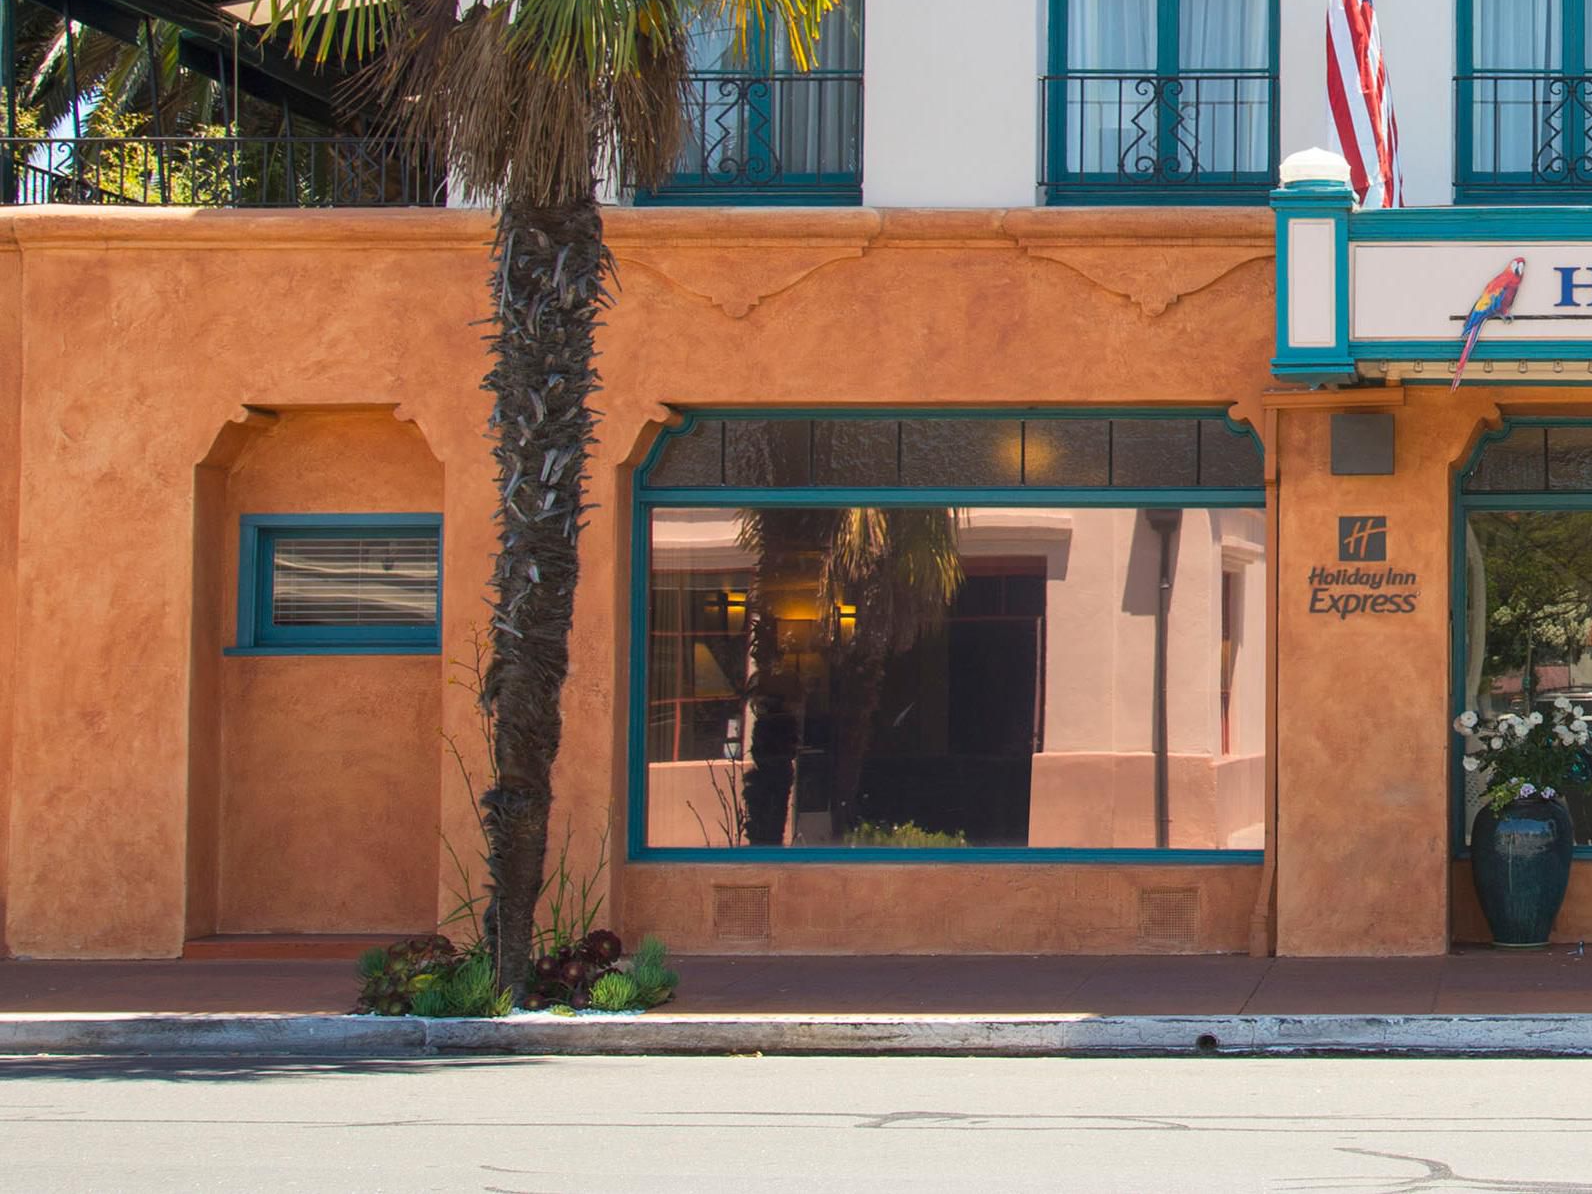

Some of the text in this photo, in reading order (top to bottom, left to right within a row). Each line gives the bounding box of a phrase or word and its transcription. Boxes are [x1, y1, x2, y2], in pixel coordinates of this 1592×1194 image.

[1308, 566, 1416, 590] Holiday Inn
[1309, 587, 1417, 620] Express
